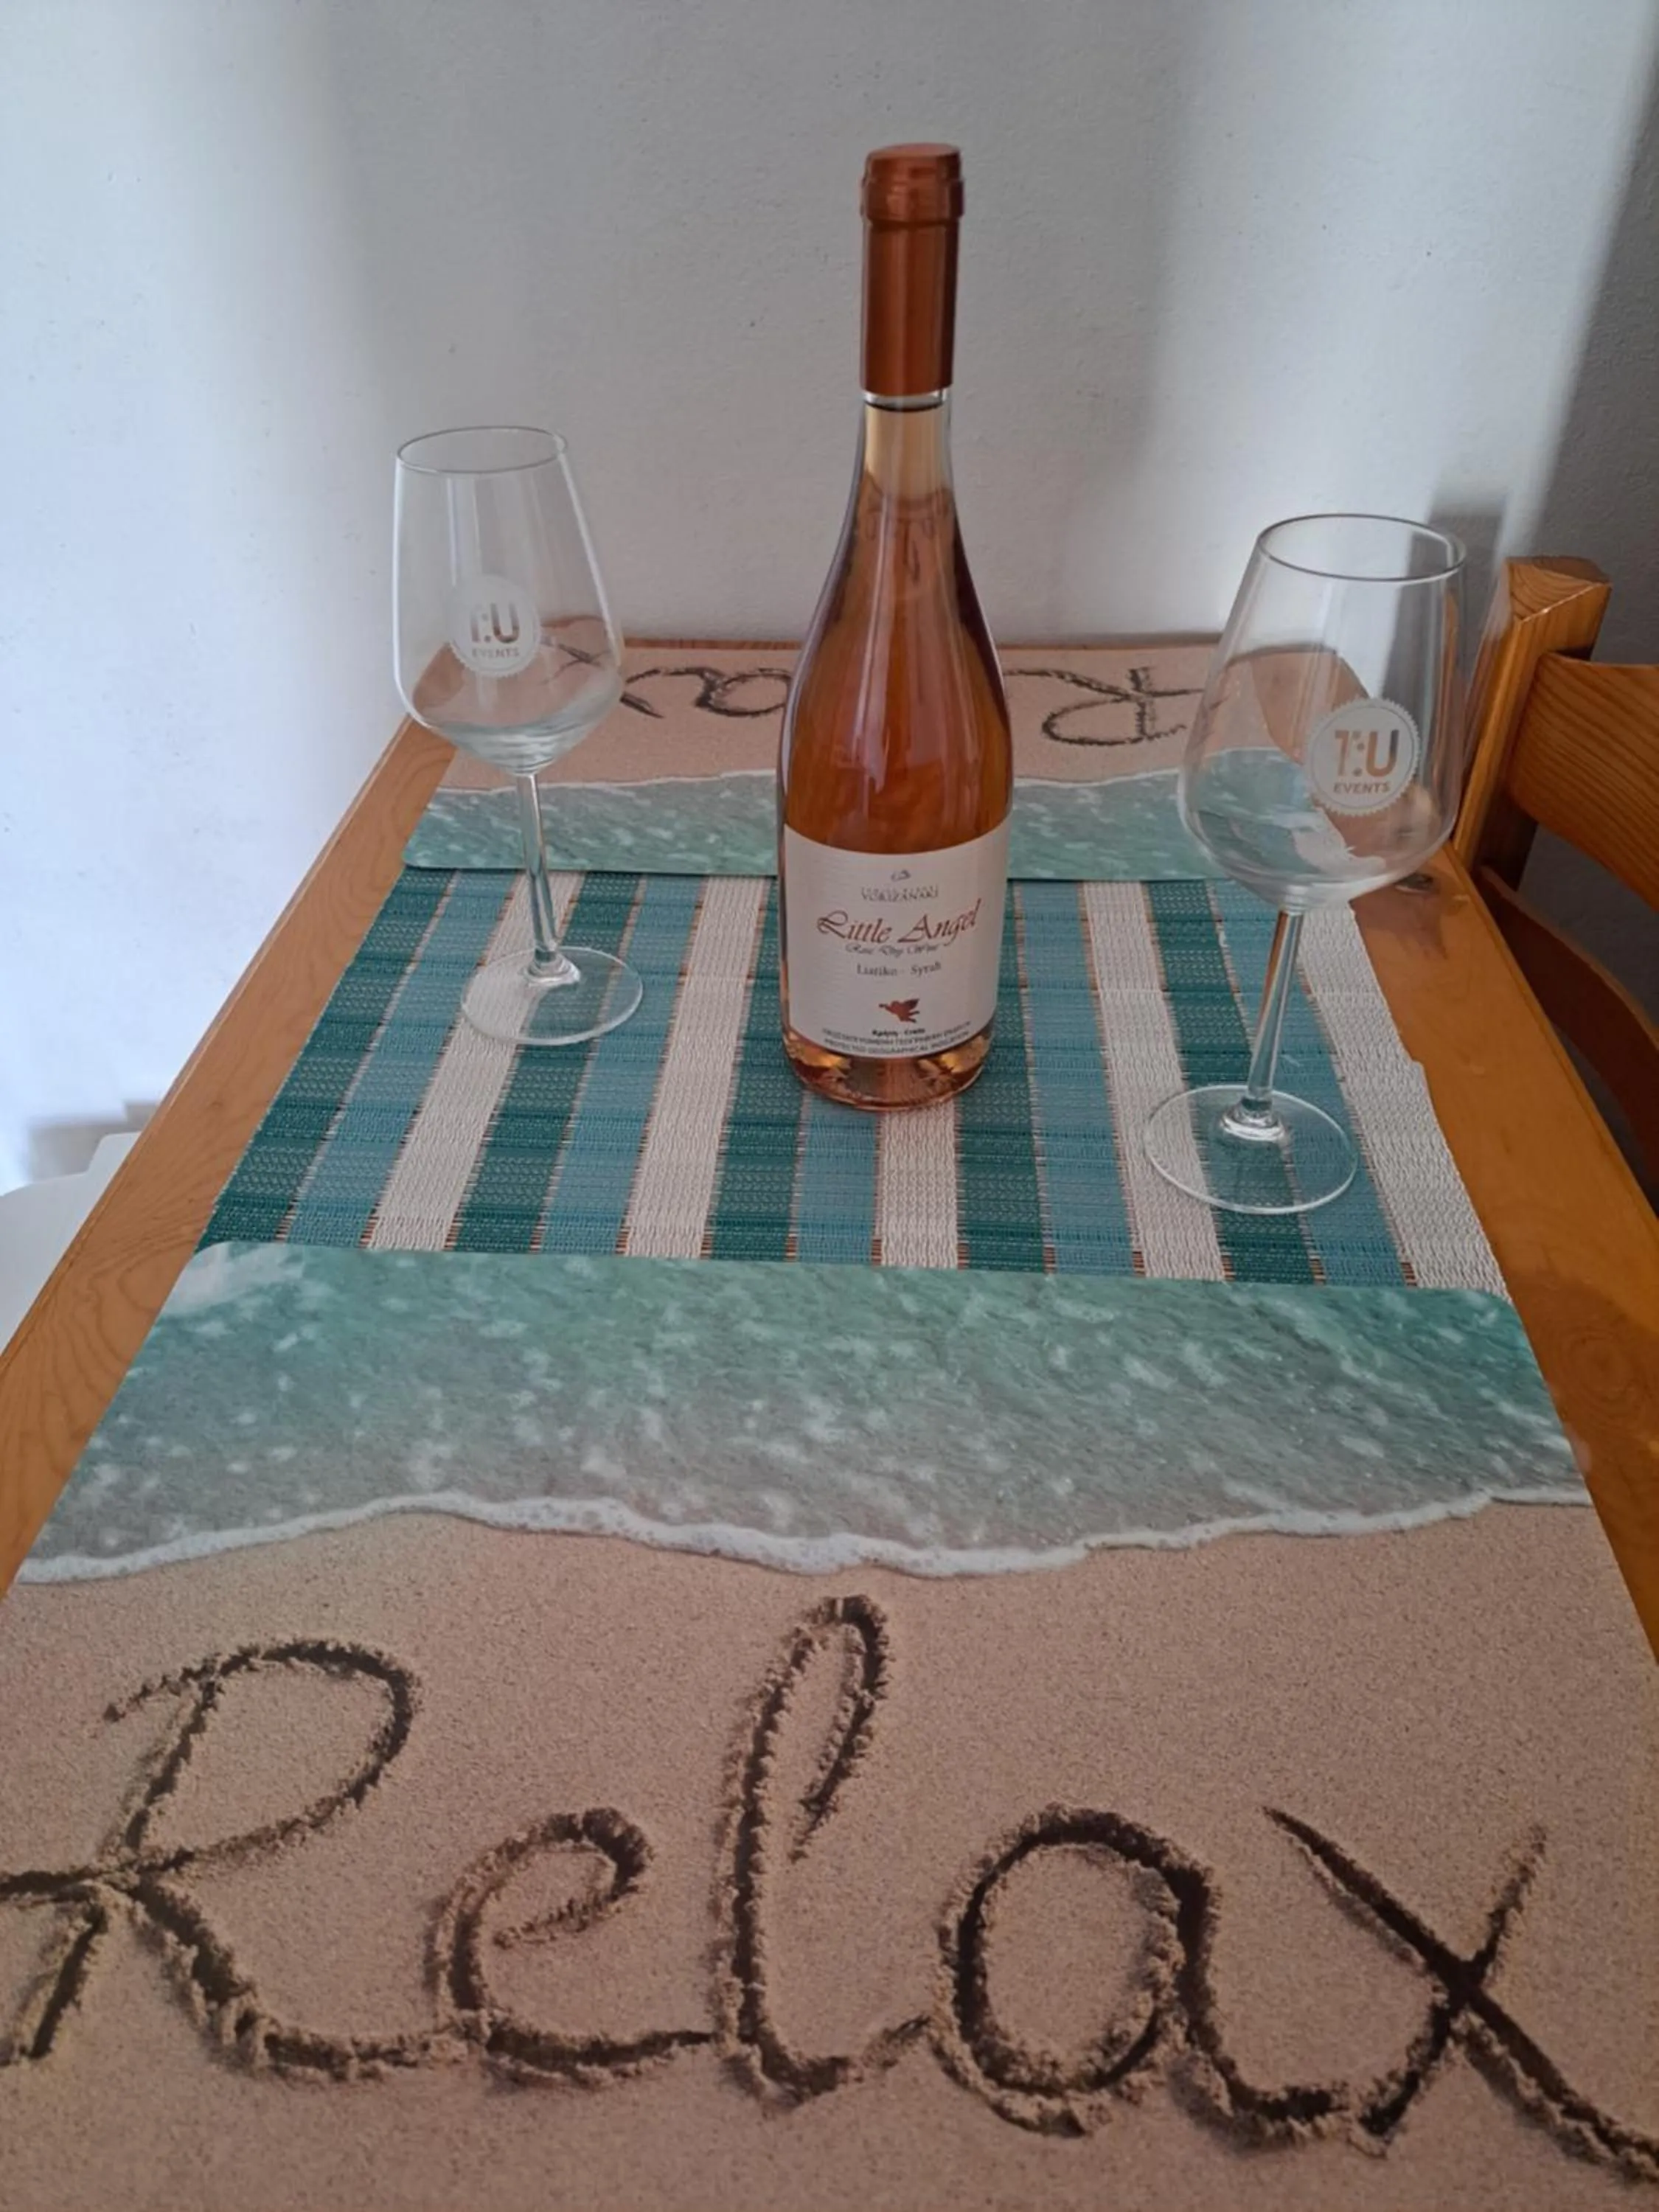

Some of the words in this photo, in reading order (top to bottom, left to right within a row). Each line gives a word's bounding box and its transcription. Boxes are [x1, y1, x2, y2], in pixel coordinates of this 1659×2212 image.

[471, 647, 520, 658] EVENTS
[1332, 780, 1391, 795] EVENTS
[816, 910, 893, 945] Little
[897, 898, 983, 947] Angel
[910, 961, 942, 977] Syrah
[0, 1594, 1659, 2187] Relax
